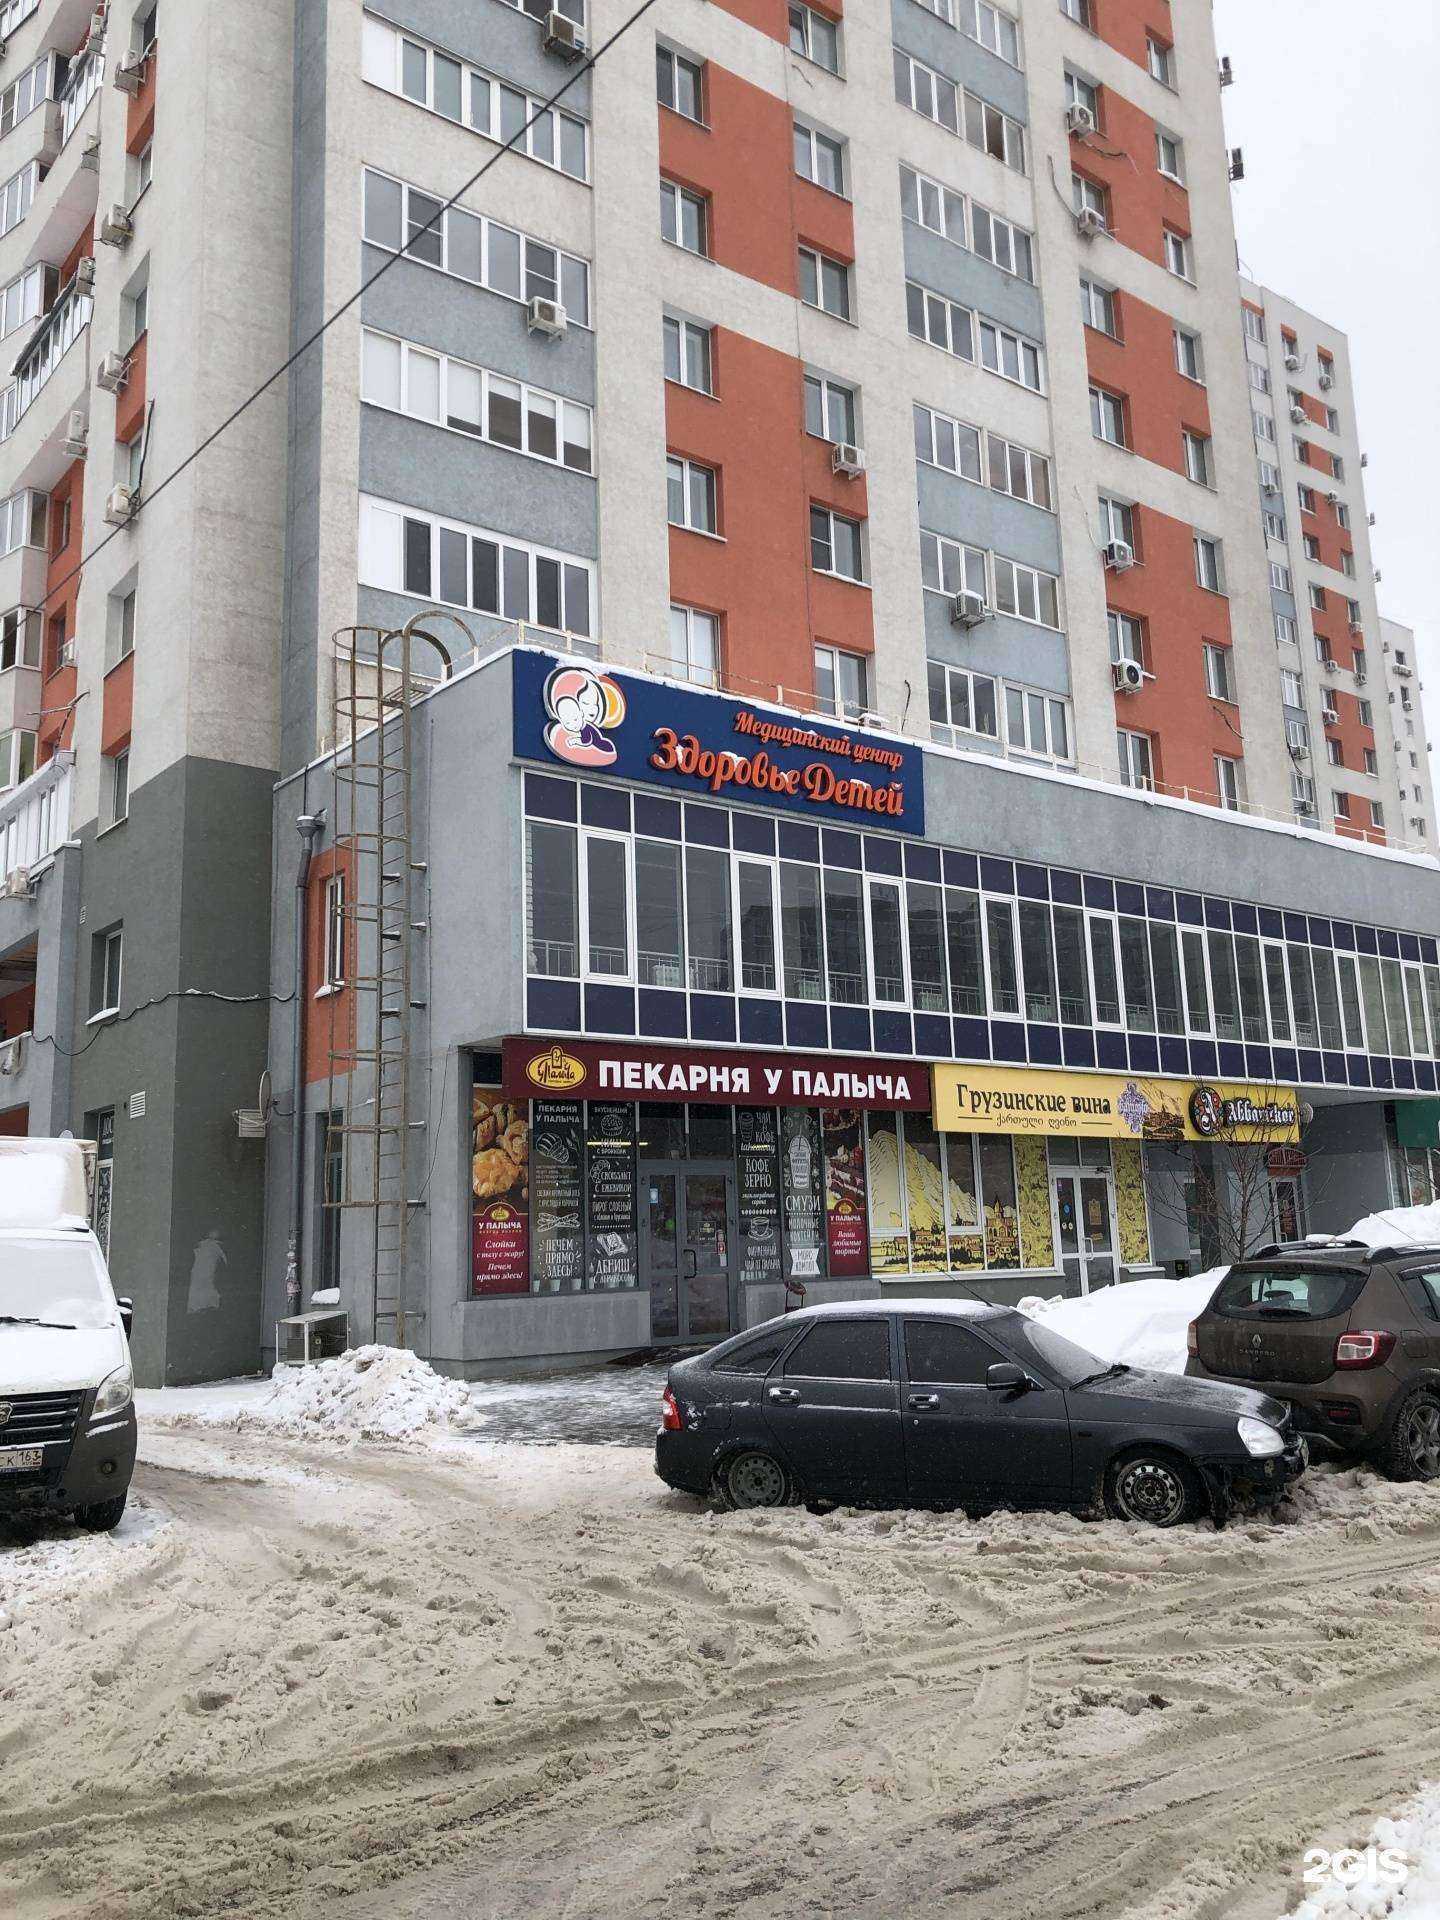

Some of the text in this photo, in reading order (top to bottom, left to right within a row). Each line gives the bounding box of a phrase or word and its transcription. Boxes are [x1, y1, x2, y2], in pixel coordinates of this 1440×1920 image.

[734, 711, 904, 772] Медицинский центр
[651, 727, 904, 816] Здоровье Детей
[599, 1059, 912, 1101] ПЕКАРНЯ У ПАЛЫЧА
[956, 1083, 1066, 1114] Грузинские
[1071, 1096, 1112, 1114] вина
[538, 1104, 578, 1113] ПЕКАРНЯ
[544, 1115, 580, 1123] ПАЛЫЧА
[755, 1131, 775, 1143] КОФЕ
[745, 1158, 770, 1173] КОФЕ
[744, 1173, 772, 1188] ЗЕРНО
[785, 1195, 821, 1211] СМУЗИ
[486, 1221, 522, 1229] ПАЛЫЧА
[485, 1240, 516, 1248] Слойки
[545, 1251, 575, 1264] ПРЯМО
[19, 1451, 41, 1462] 163
